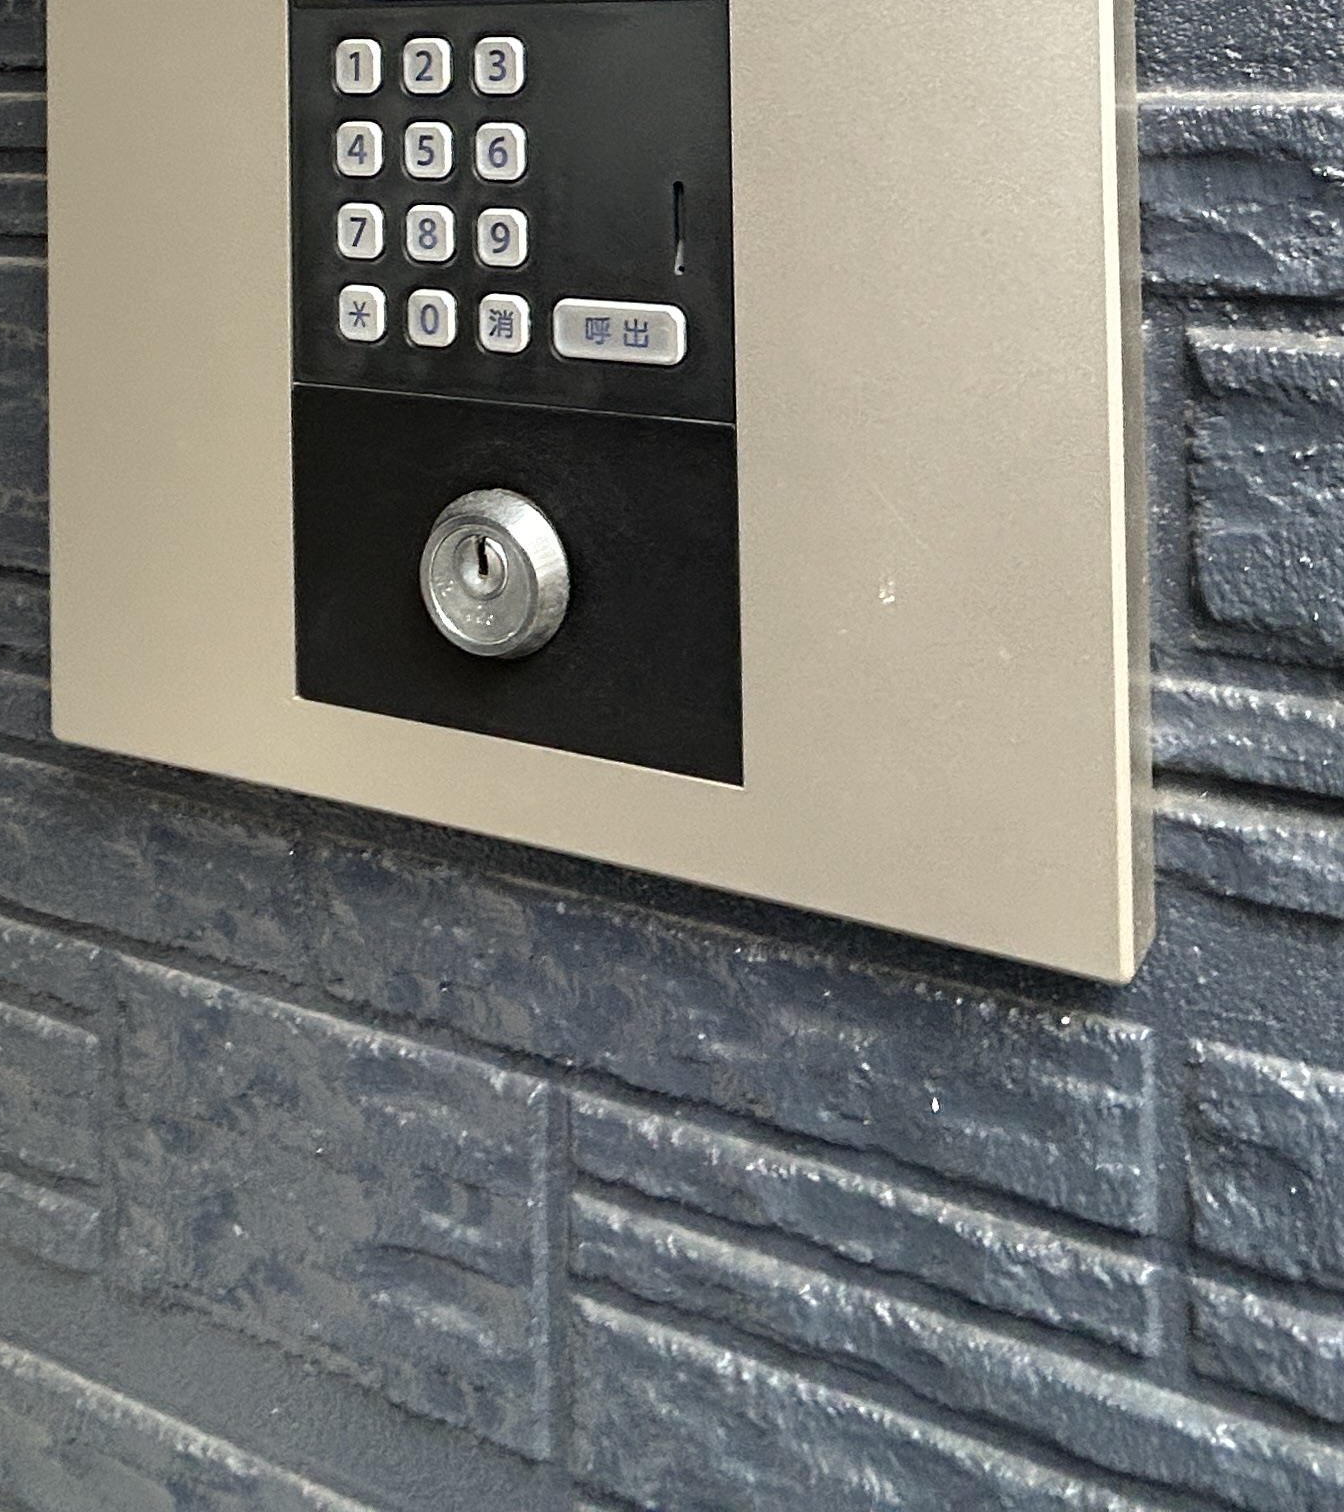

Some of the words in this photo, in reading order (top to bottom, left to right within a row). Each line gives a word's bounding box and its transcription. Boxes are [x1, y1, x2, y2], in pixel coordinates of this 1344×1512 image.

[348, 51, 360, 81] 1
[415, 50, 434, 82] 2
[488, 50, 507, 82] 3
[347, 134, 367, 165] 4
[416, 135, 435, 166] 5
[488, 136, 508, 168] 6
[349, 216, 368, 248] 7
[418, 217, 438, 251] 8
[490, 221, 510, 254] 9
[420, 303, 439, 336] 0
[488, 309, 514, 339] 消
[585, 316, 649, 349] 呼出
